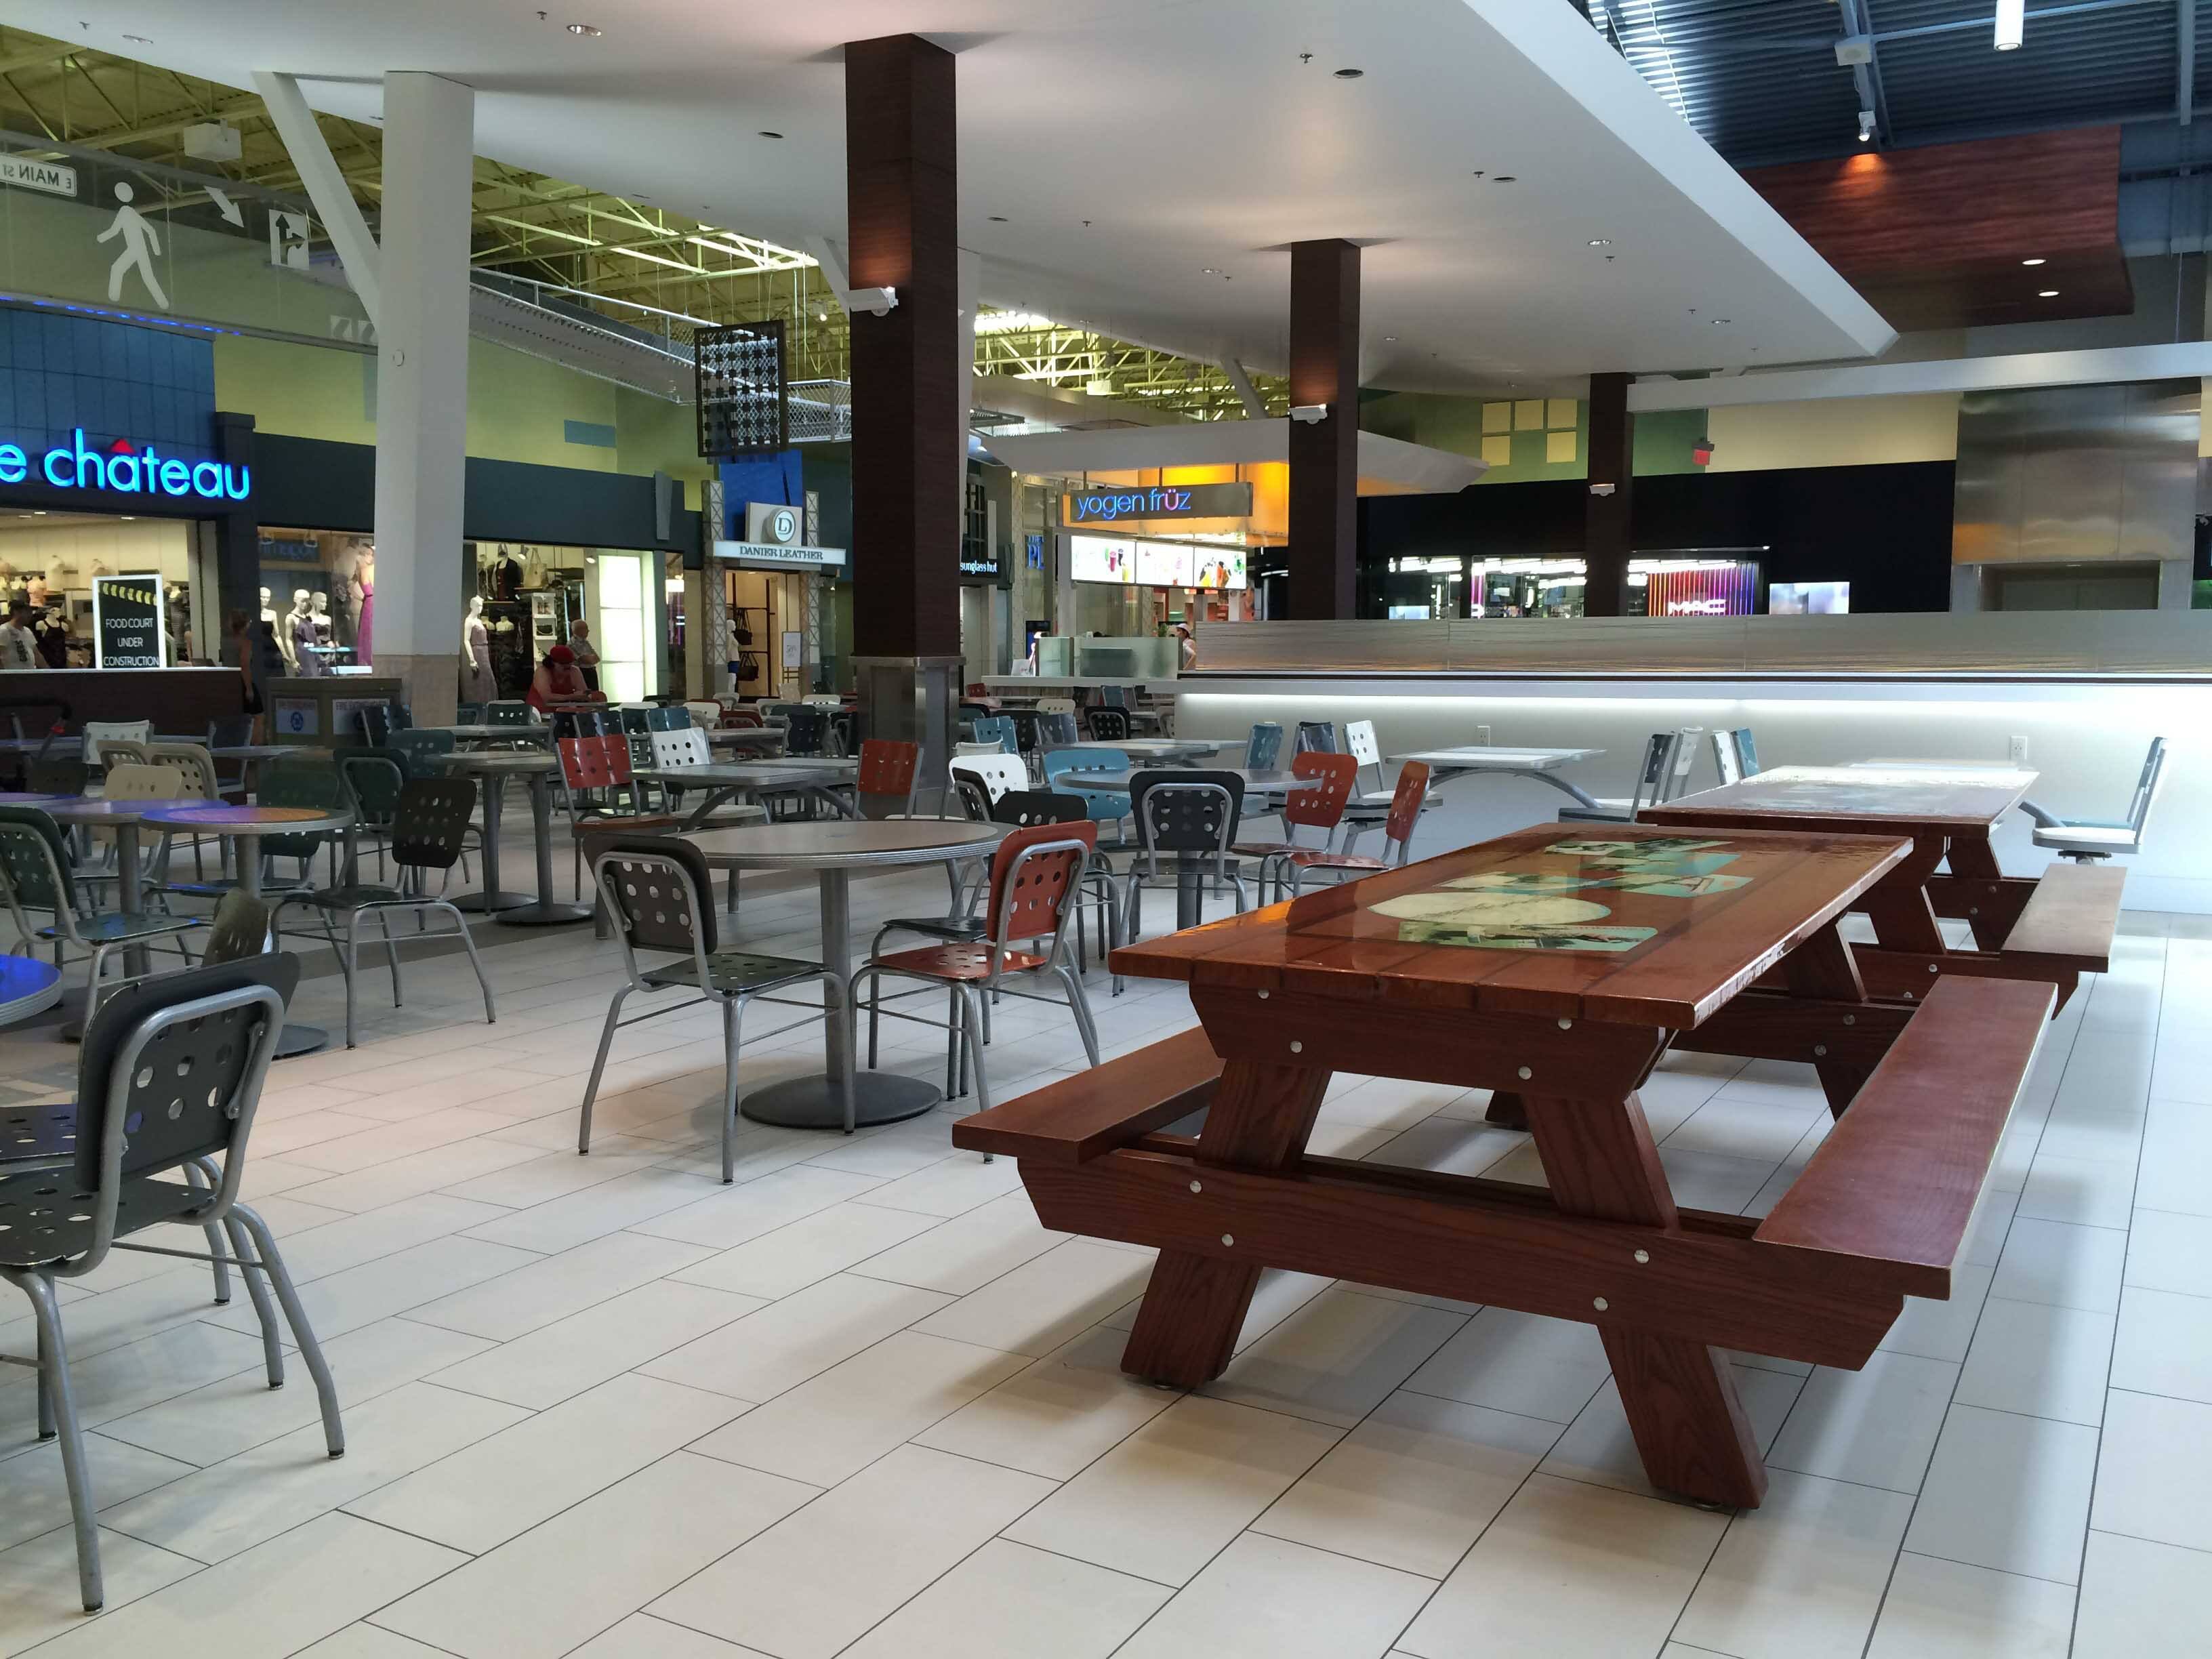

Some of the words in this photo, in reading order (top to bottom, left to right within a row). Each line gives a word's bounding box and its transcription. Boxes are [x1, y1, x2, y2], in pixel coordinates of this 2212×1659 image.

[1077, 493, 1145, 520] yogen
[1149, 488, 1191, 512] früz
[739, 546, 779, 557] DANIER
[779, 549, 823, 560] LEATHER
[960, 560, 986, 574] sunglass
[987, 561, 998, 573] hut
[1668, 600, 1726, 614] MAC
[106, 618, 127, 628] FOOD
[128, 618, 153, 628] COURT
[117, 637, 143, 647] UNDER
[103, 656, 159, 666] CONSTRUCTION
